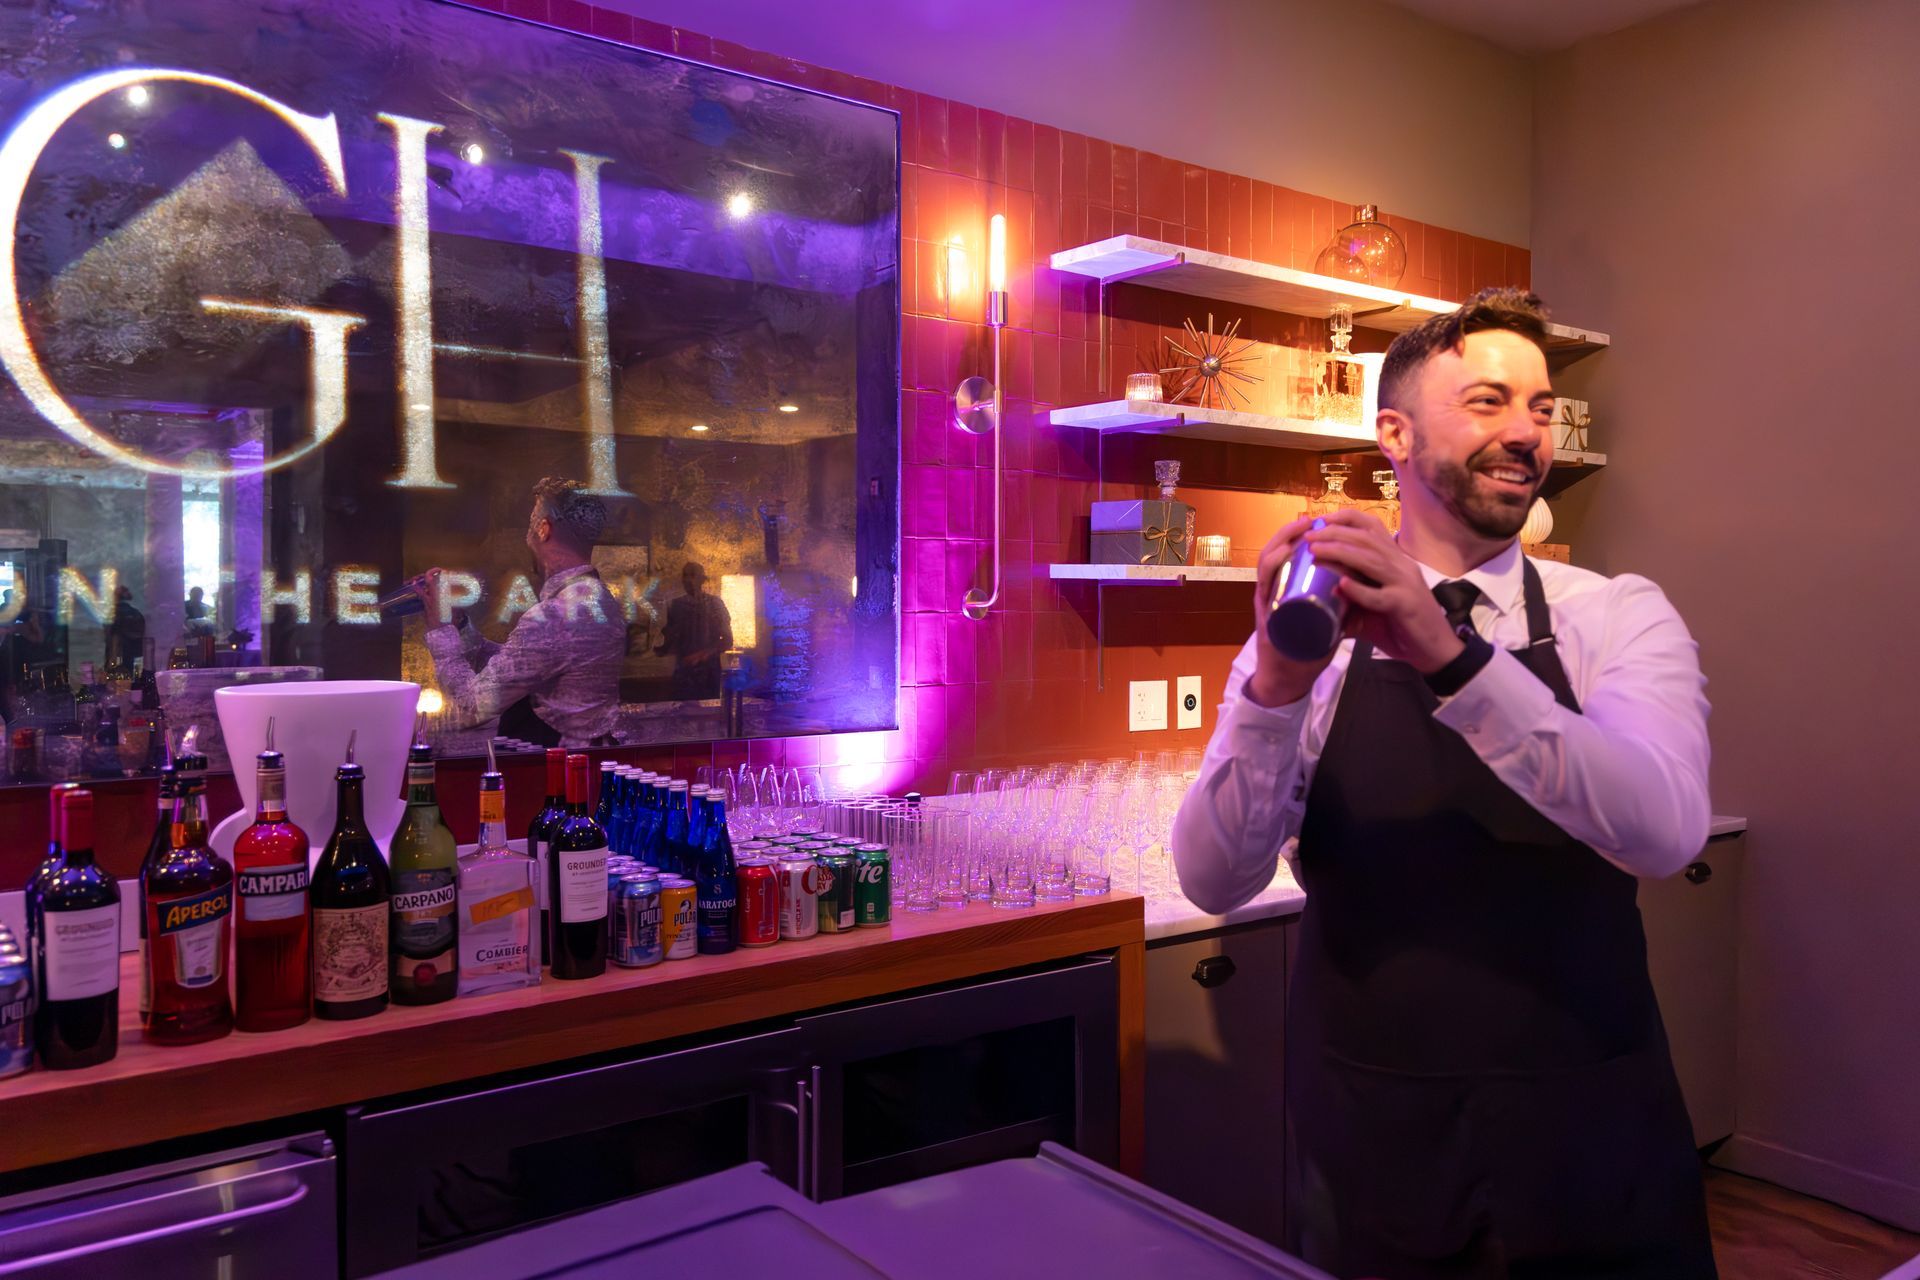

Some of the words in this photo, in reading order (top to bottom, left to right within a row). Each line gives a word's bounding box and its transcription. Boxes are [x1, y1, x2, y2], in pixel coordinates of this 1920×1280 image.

[219, 566, 381, 625] HE
[437, 569, 660, 624] PARK
[239, 871, 309, 894] CAMPARI
[166, 894, 228, 928] APEROL
[394, 888, 453, 910] CARPANO
